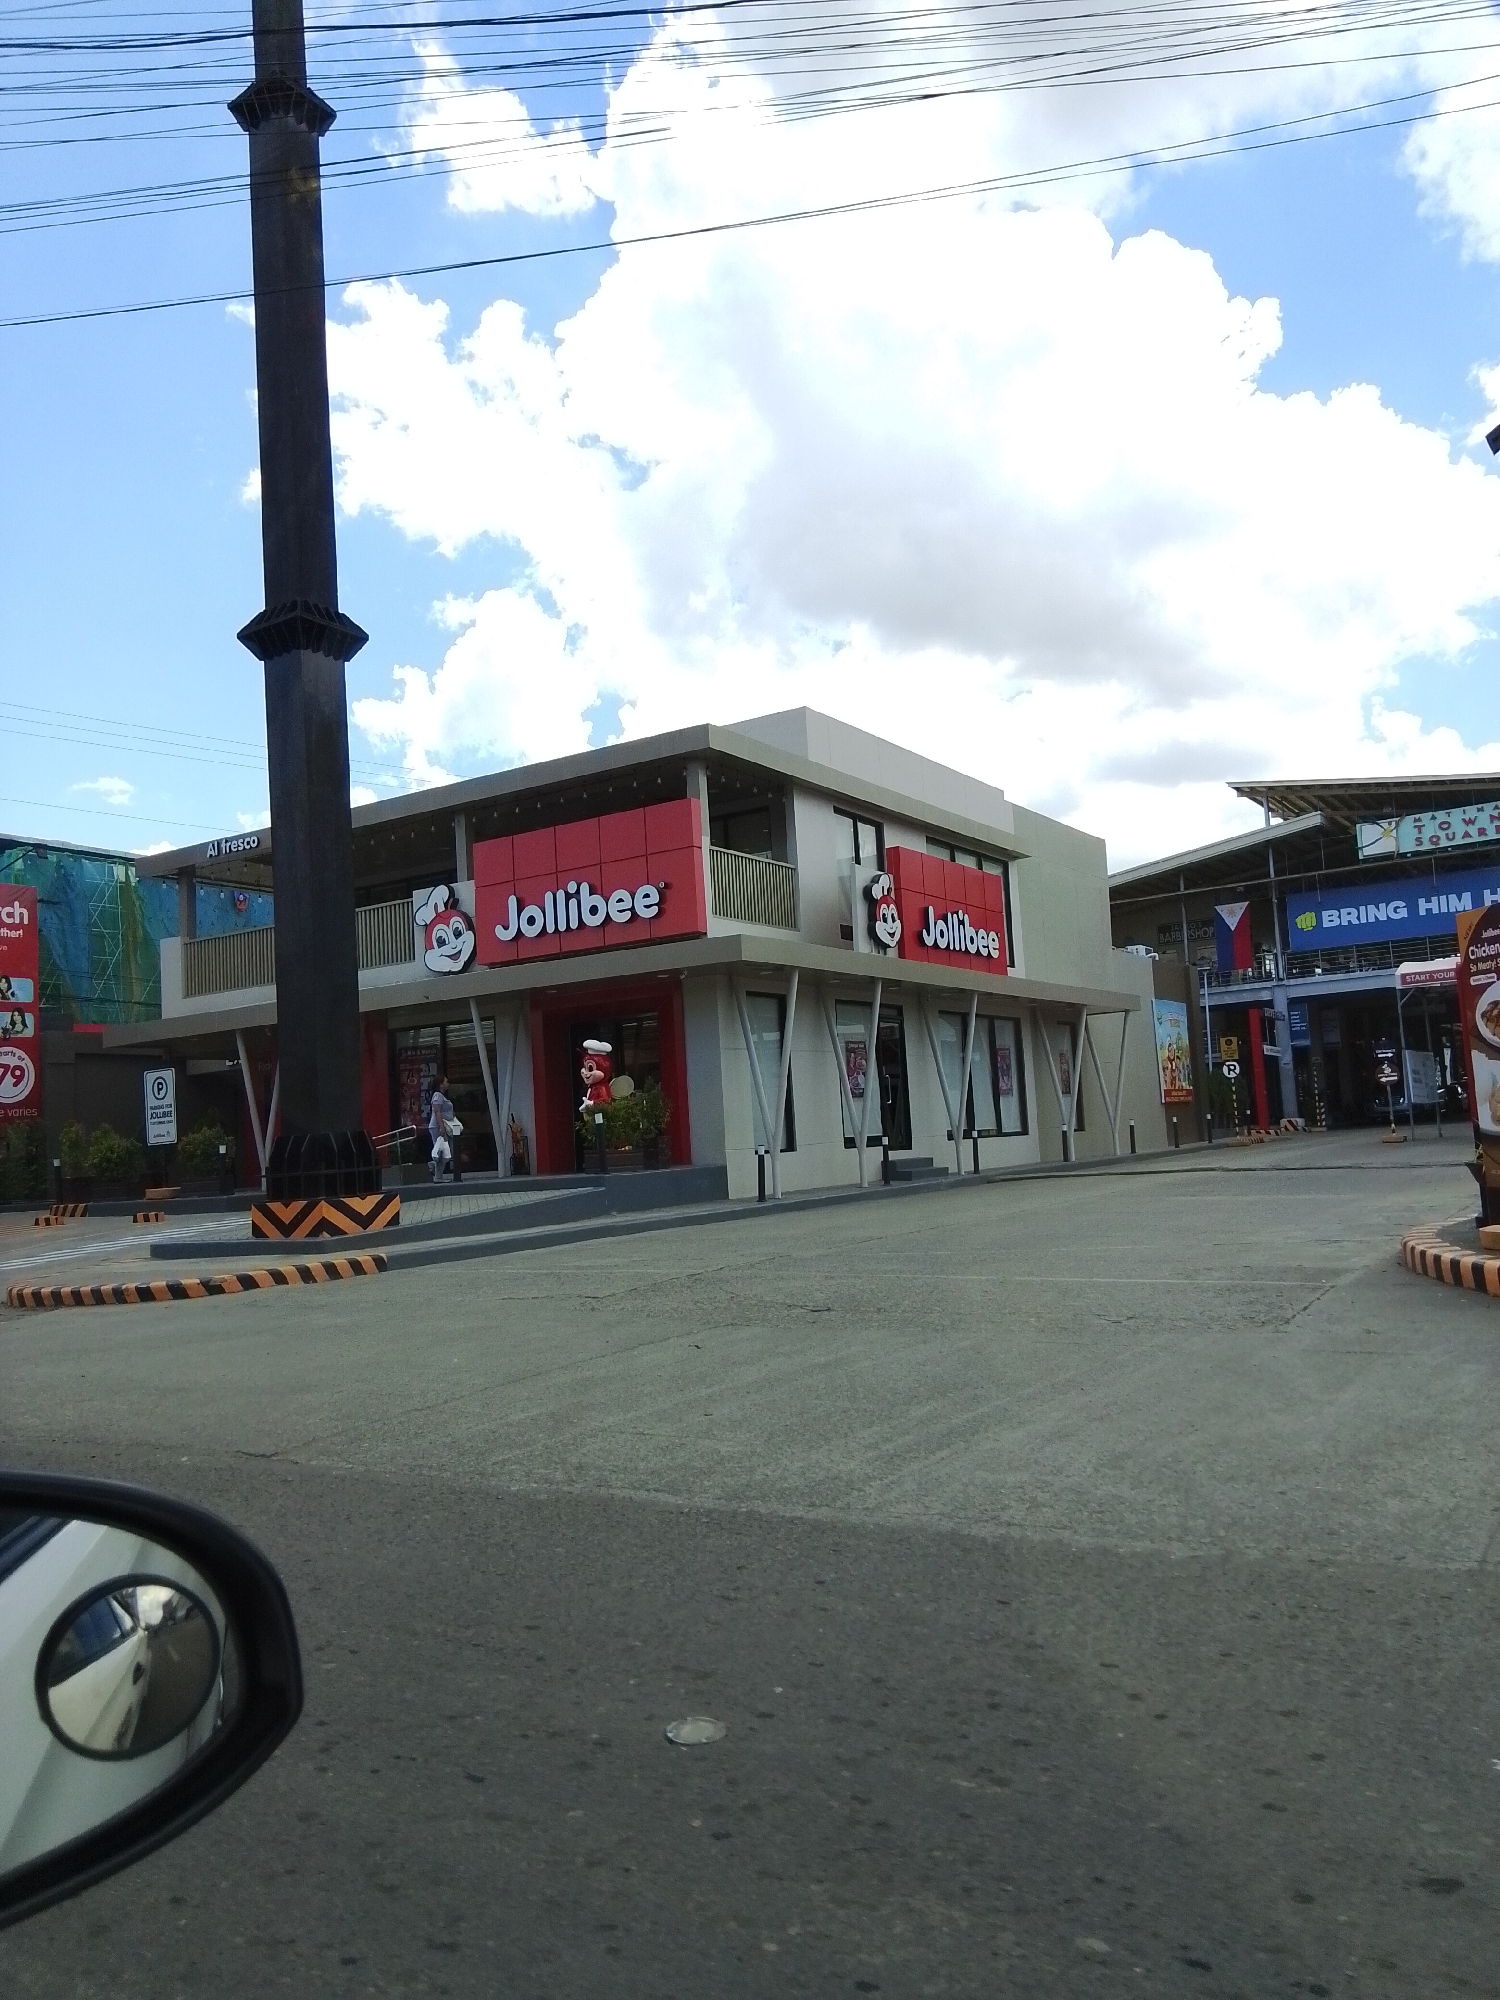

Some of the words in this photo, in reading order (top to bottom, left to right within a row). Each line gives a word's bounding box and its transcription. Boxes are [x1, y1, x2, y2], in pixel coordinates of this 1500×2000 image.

[1413, 804, 1500, 823] MATINA
[206, 840, 218, 858] Al
[221, 836, 258, 854] fresco
[494, 880, 660, 941] Jollibee
[1322, 900, 1409, 928] BRING
[1418, 891, 1473, 916] HIM
[922, 905, 1000, 959] Jollibee
[1468, 942, 1500, 960] Chicken
[1406, 973, 1430, 982] START
[1432, 970, 1456, 981] YOUR
[1470, 963, 1477, 973] So
[7, 1106, 38, 1117] varies
